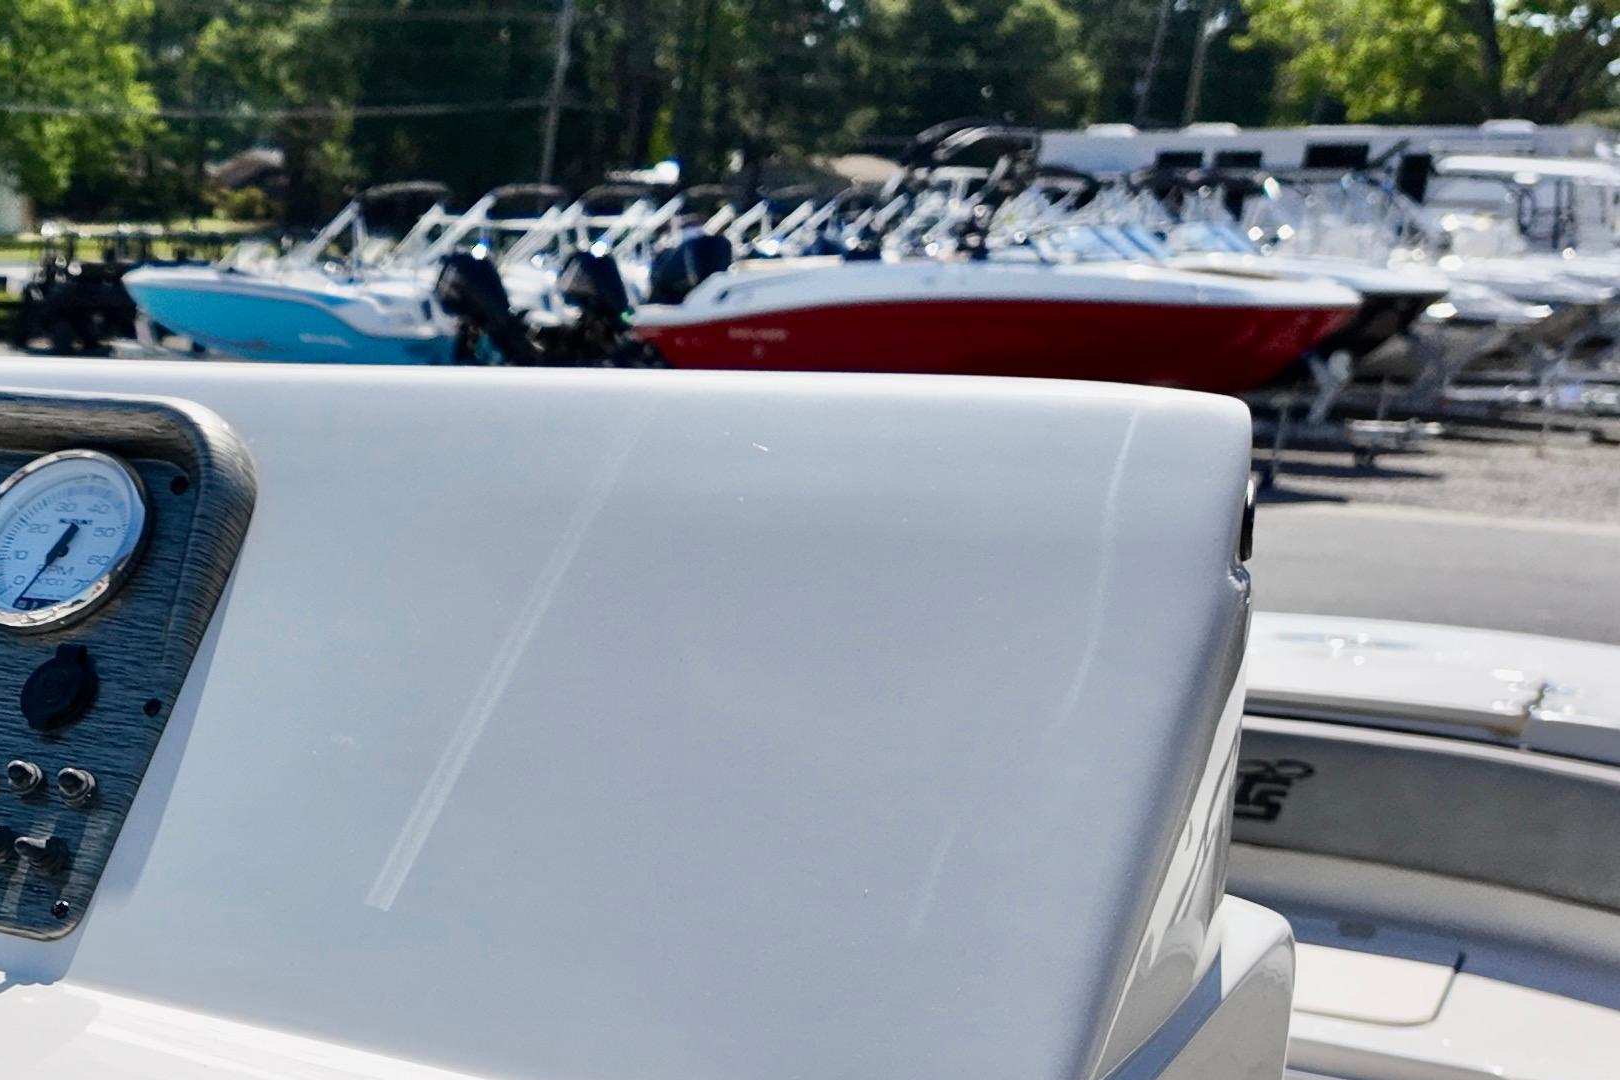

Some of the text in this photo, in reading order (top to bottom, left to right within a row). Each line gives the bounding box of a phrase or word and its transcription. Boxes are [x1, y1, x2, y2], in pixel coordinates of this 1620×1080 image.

[54, 503, 77, 513] 30
[87, 504, 110, 515] 40
[27, 524, 51, 535] 20
[93, 528, 116, 538] 50
[86, 555, 111, 566] 60
[12, 576, 26, 586] 0
